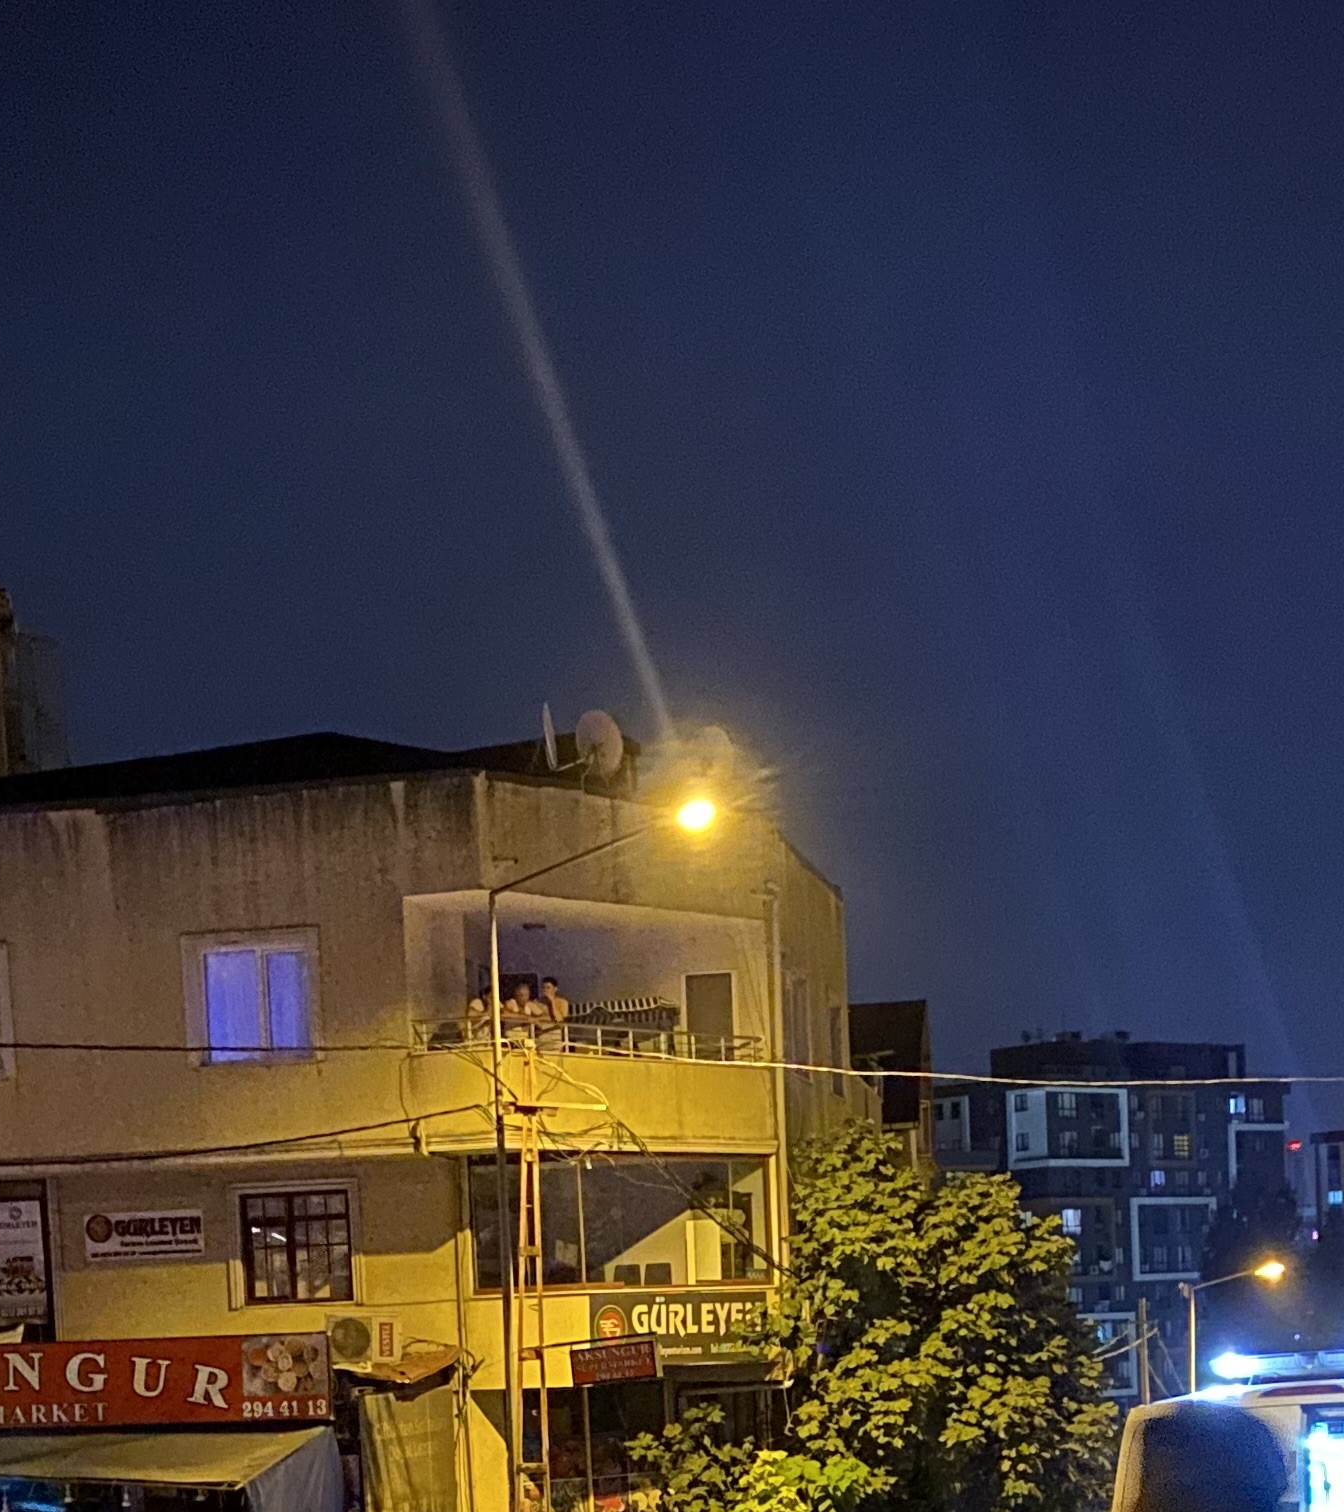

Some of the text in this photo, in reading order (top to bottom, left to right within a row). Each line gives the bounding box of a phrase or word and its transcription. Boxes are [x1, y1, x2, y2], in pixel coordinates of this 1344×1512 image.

[242, 1399, 328, 1418] 294 41 13
